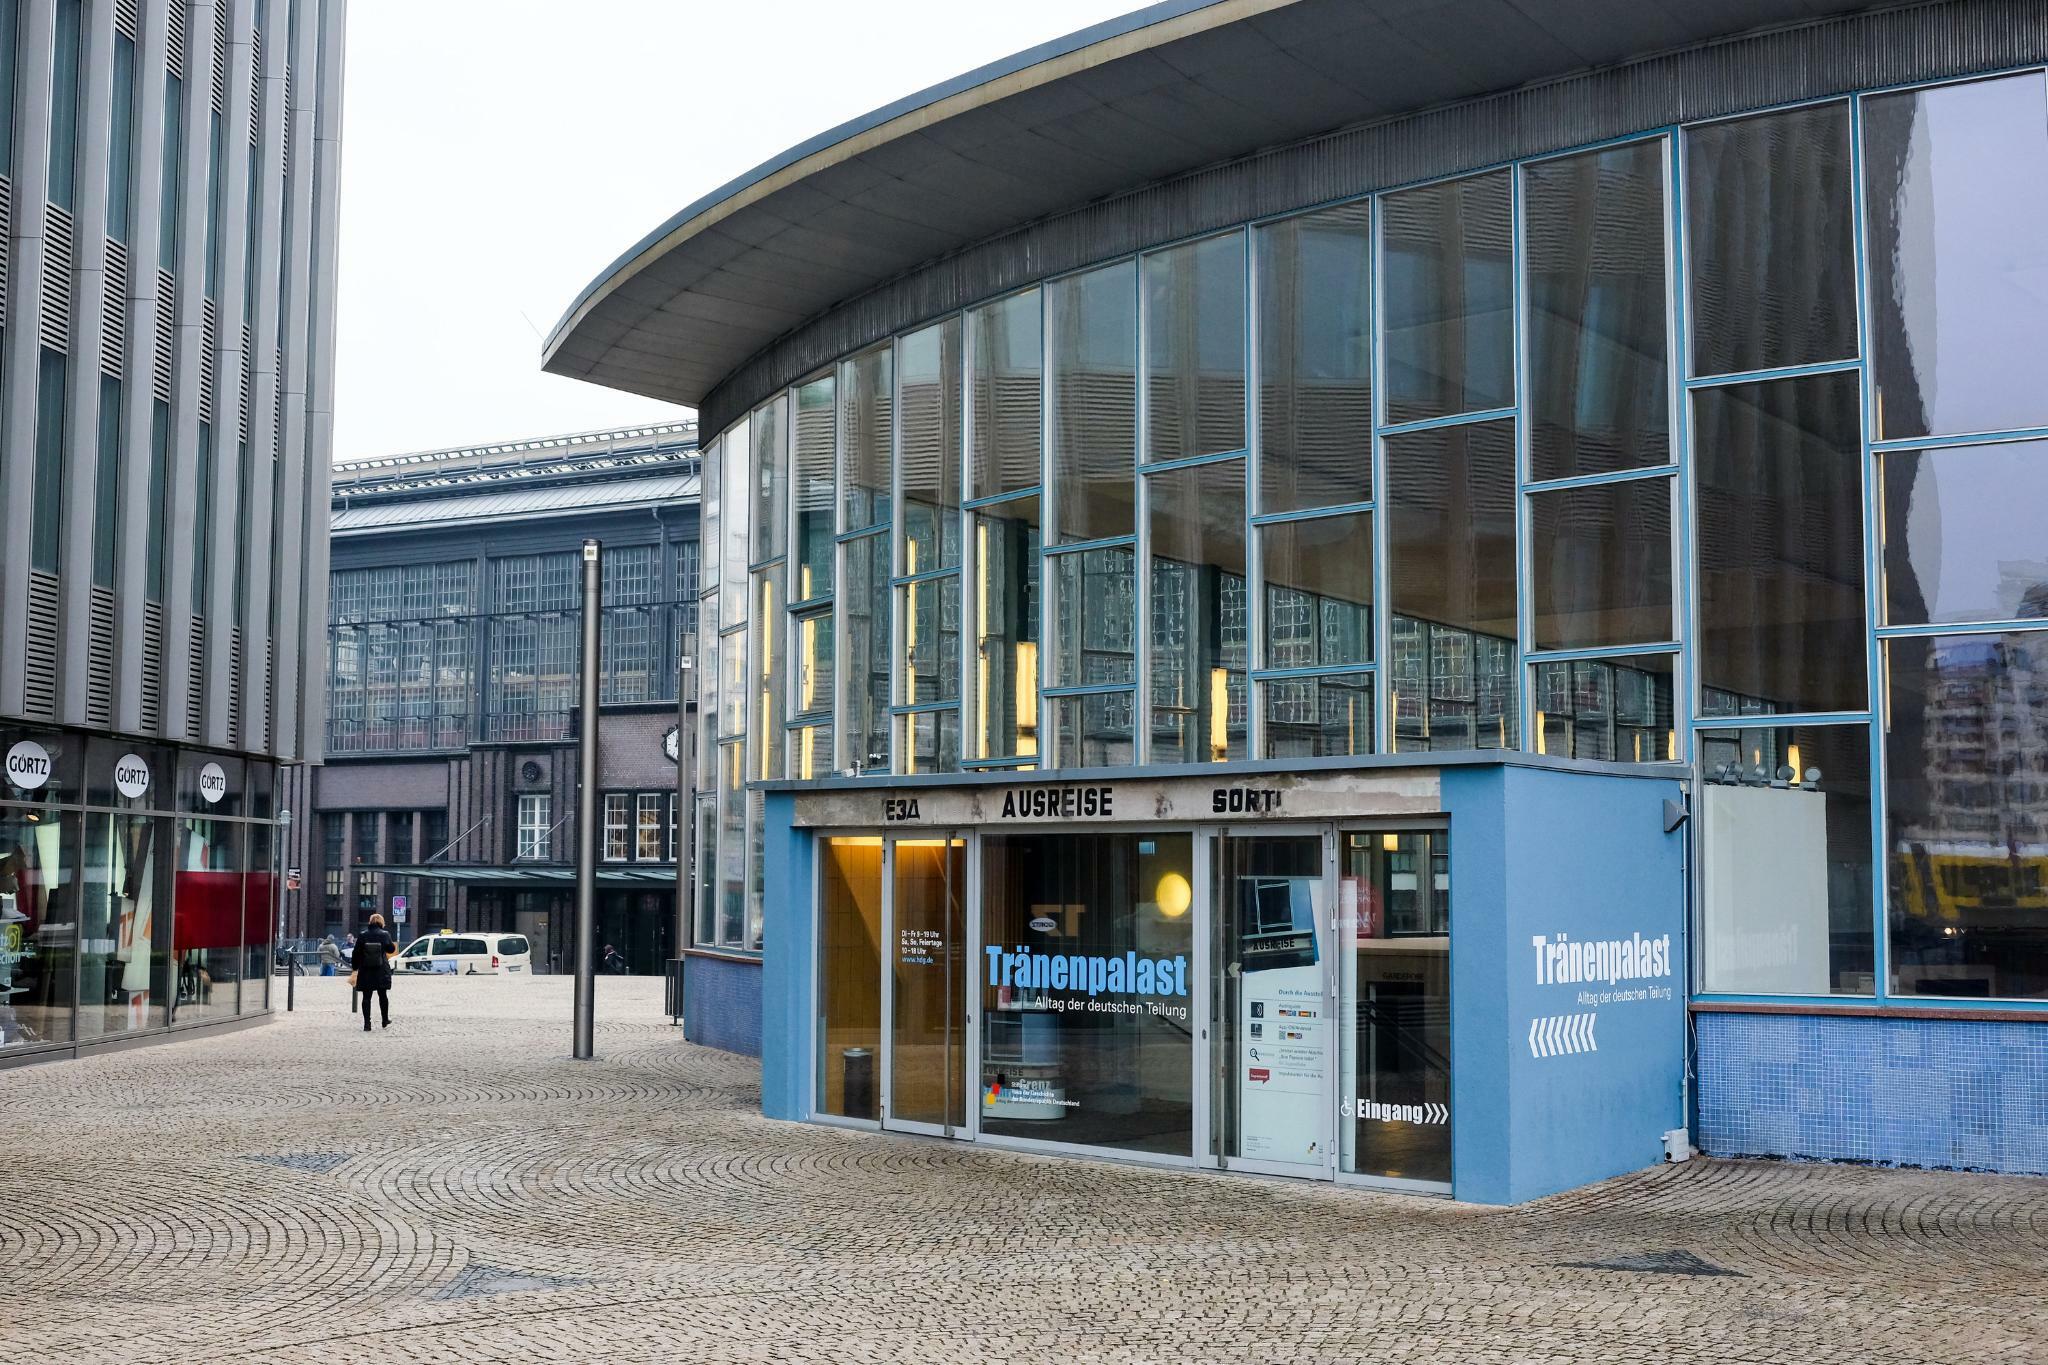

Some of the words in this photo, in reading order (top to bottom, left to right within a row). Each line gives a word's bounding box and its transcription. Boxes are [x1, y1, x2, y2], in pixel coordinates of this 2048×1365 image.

[1001, 788, 1112, 817] AUSREISE
[986, 945, 1186, 996] Tränenpalast
[1533, 932, 1671, 985] Tränenpalast
[1035, 996, 1064, 1012] Alltag
[1067, 998, 1084, 1011] der
[1087, 999, 1143, 1014] deutschen
[1146, 1002, 1187, 1019] Teilung
[1577, 991, 1598, 1007] Alltag
[1600, 989, 1612, 1003] der
[1613, 988, 1647, 1002] deutschen
[1648, 985, 1671, 1000] Teilung
[1053, 1099, 1080, 1107] Deutschland
[1357, 1098, 1423, 1125] Eingang
